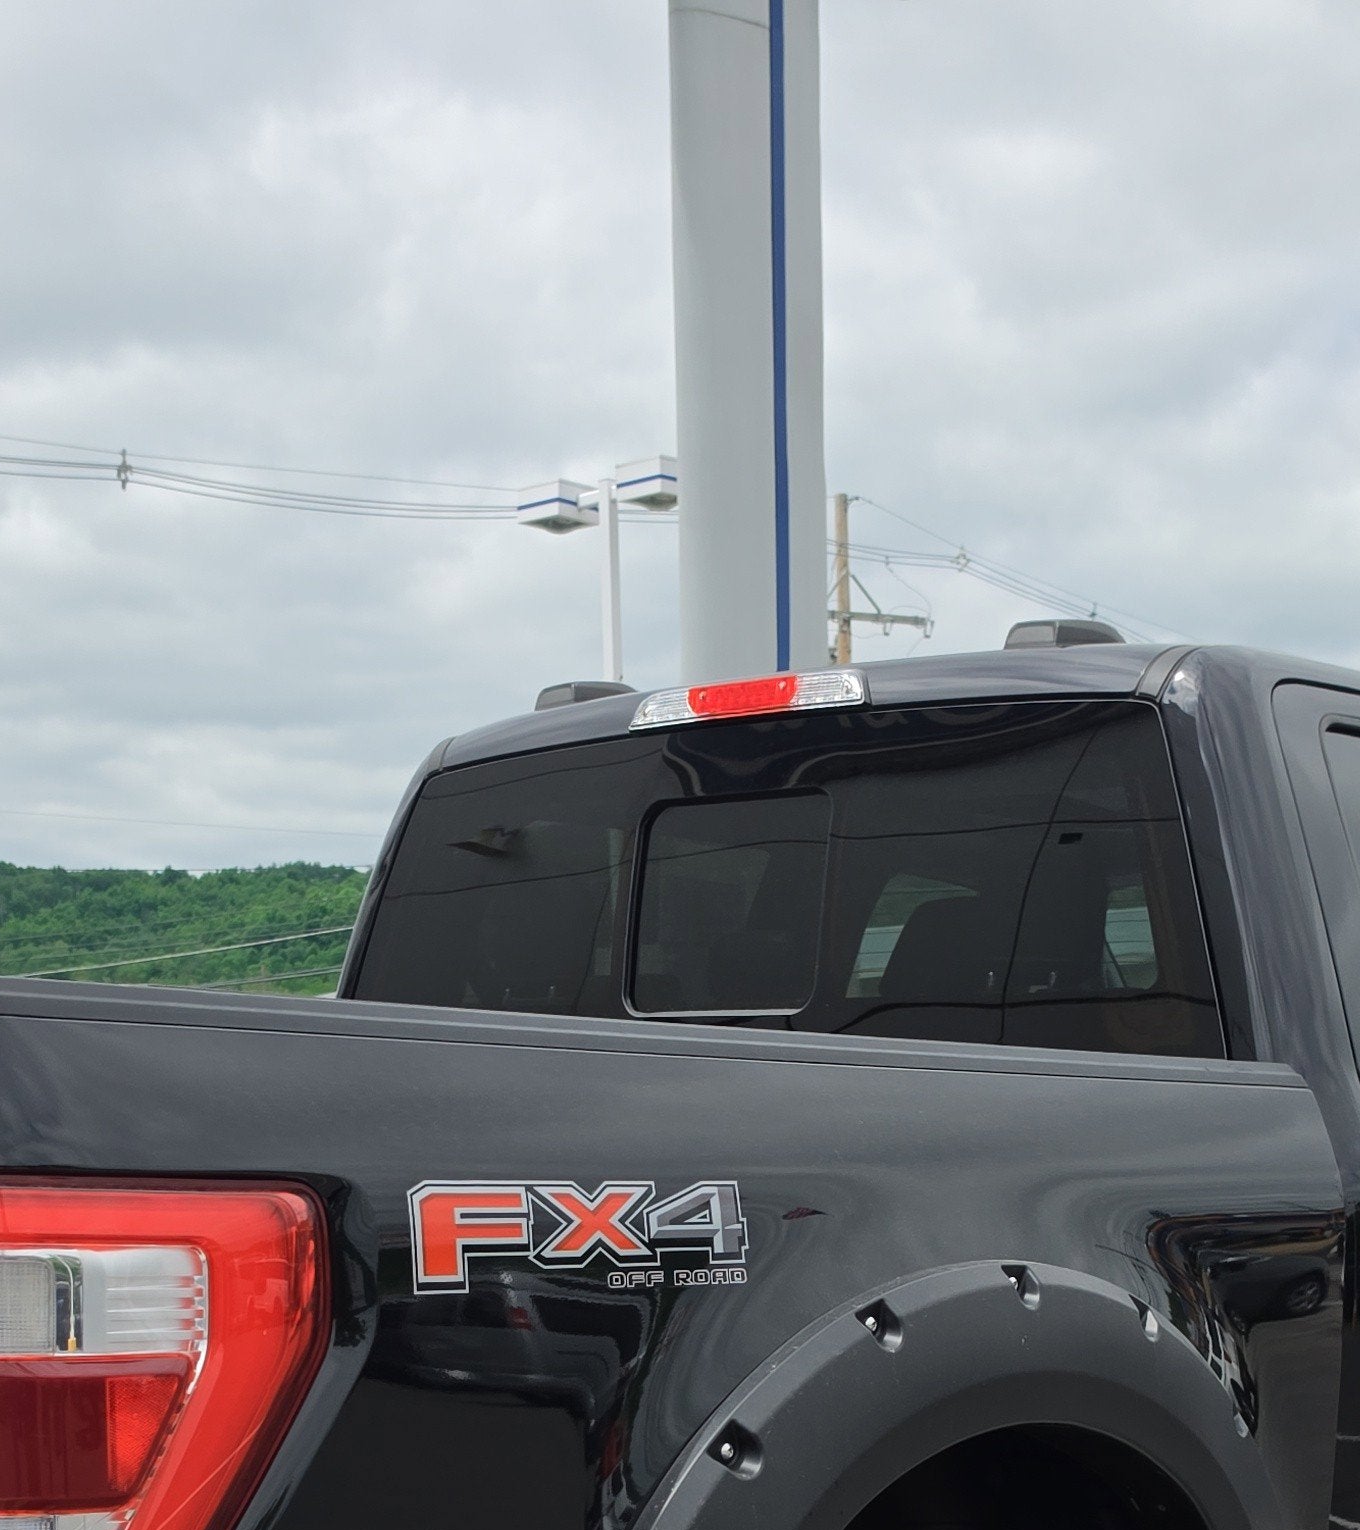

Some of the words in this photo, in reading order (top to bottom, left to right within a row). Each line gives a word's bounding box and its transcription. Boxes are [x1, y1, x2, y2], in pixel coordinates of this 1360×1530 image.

[406, 1180, 749, 1295] FX4
[607, 1271, 665, 1288] OFF
[673, 1268, 748, 1286] ROAD
